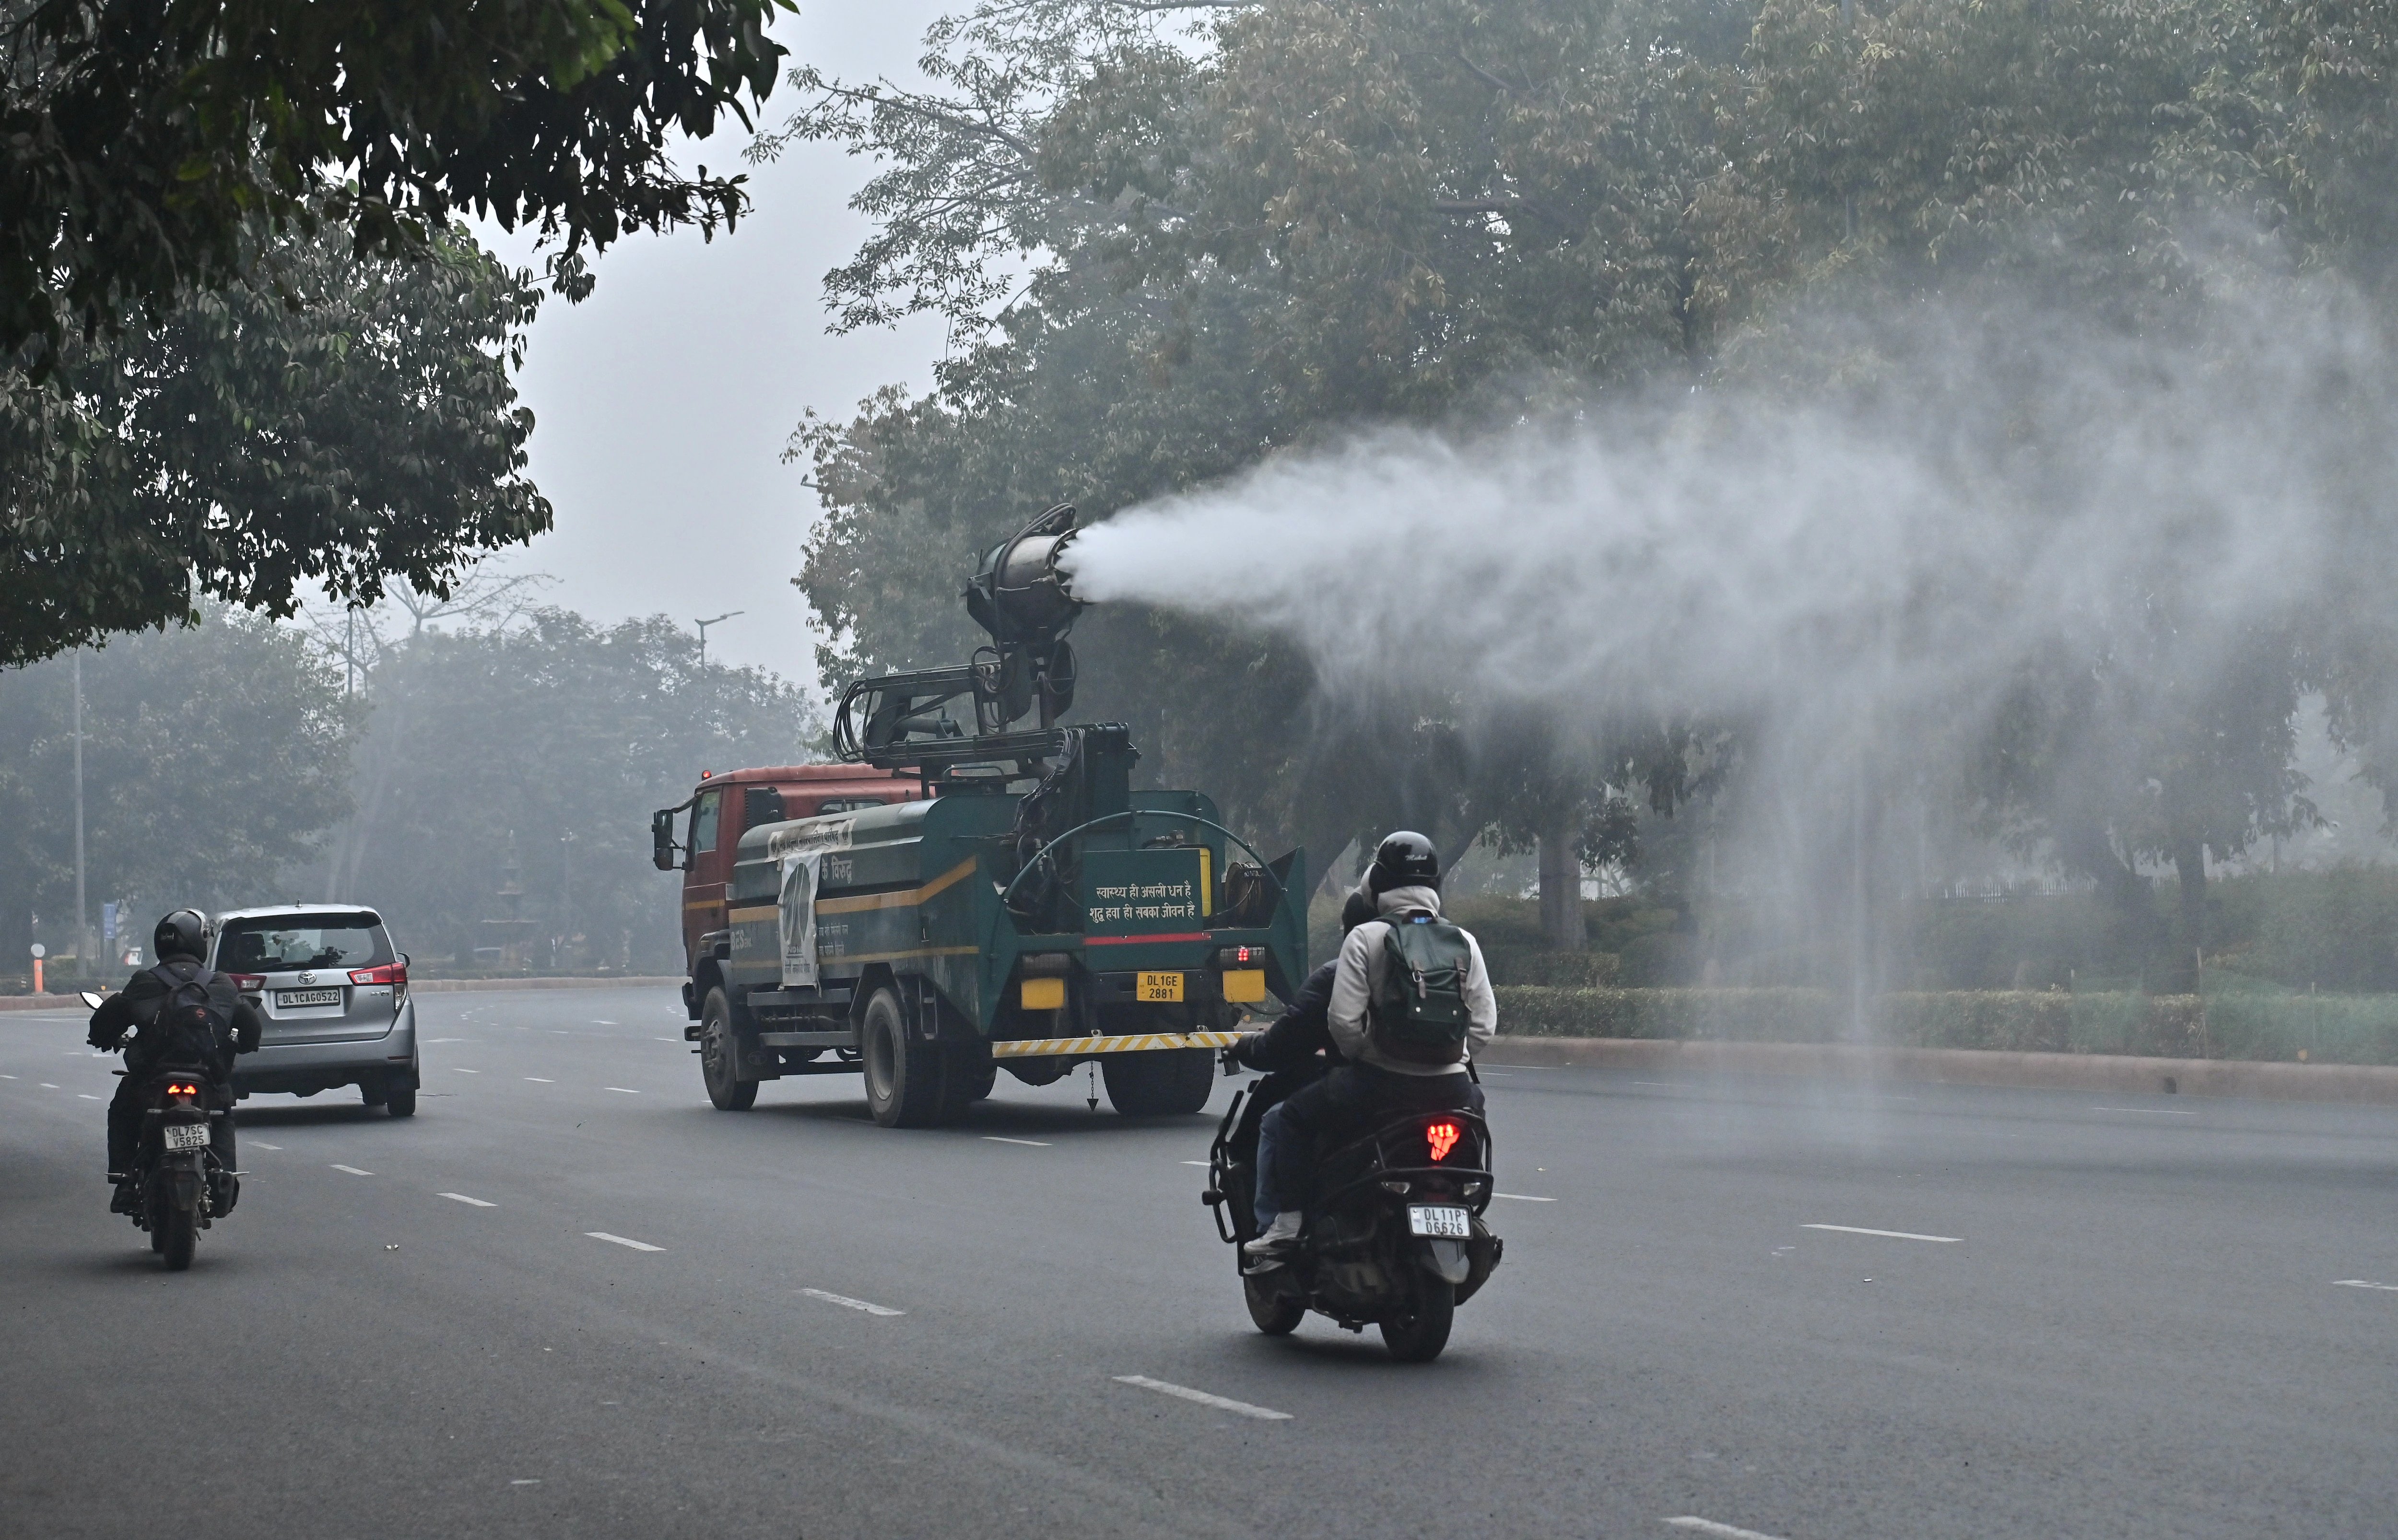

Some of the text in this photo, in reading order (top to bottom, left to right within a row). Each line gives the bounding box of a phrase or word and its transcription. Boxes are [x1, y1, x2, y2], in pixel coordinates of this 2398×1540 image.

[1096, 880, 1191, 900] स्वास्थ्य ही असली धन है
[1089, 901, 1195, 923] शुद्ध हवा ही सबका जीवन है
[282, 992, 338, 1003] DL1CAG0522
[1149, 988, 1173, 999] 2881
[172, 1125, 203, 1137] DL7SC
[173, 1135, 204, 1147] V5825
[1424, 1208, 1461, 1222] DL11P
